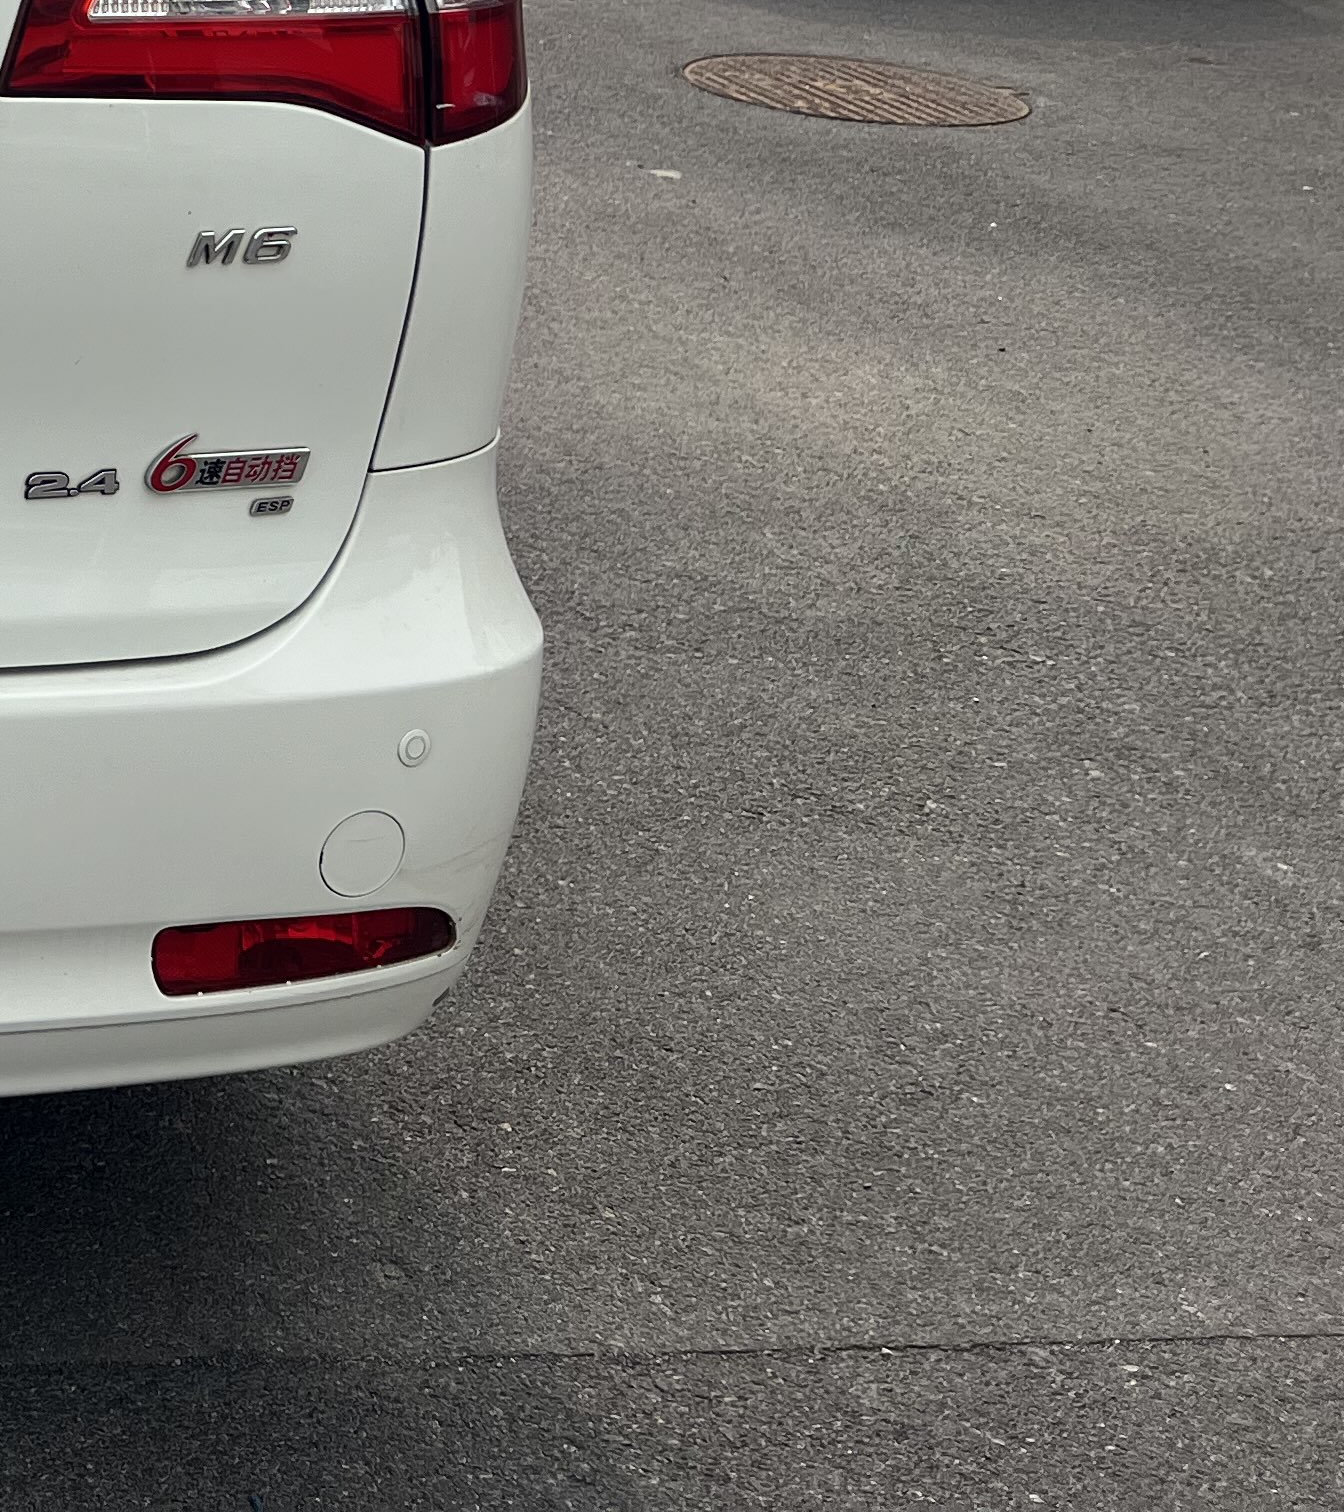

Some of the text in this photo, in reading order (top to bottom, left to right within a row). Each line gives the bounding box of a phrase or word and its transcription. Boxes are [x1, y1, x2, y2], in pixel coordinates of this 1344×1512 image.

[186, 226, 298, 268] M6
[24, 468, 120, 500] 2.4
[256, 499, 291, 513] ESP
